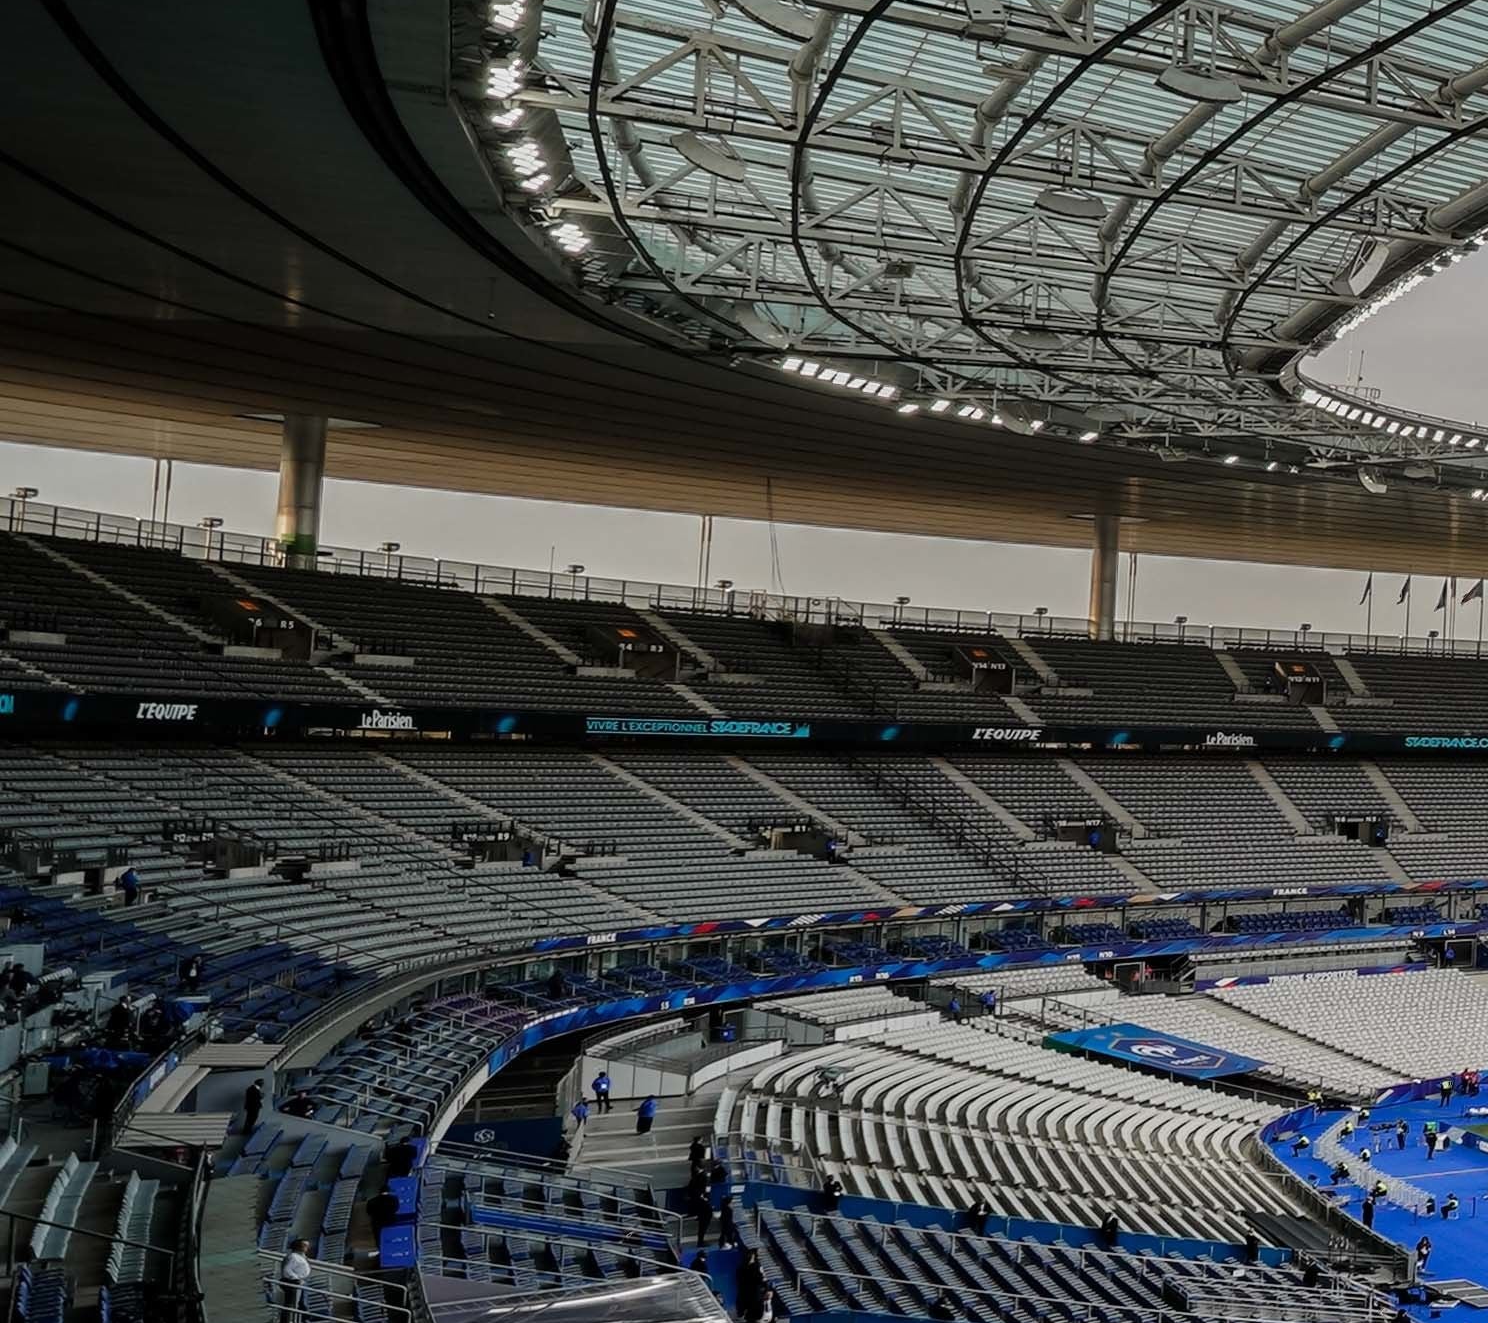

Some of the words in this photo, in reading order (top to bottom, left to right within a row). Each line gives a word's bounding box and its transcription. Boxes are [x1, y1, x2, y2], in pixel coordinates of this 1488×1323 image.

[373, 708, 413, 729] Parisien
[586, 720, 619, 731] VIVRE
[621, 721, 708, 734] L'EXCEPTIONNEL
[710, 721, 792, 735] STADEFRANCE
[1217, 731, 1255, 745] Parisien
[1273, 887, 1308, 896] FRANCE
[586, 932, 617, 945] FRANCE
